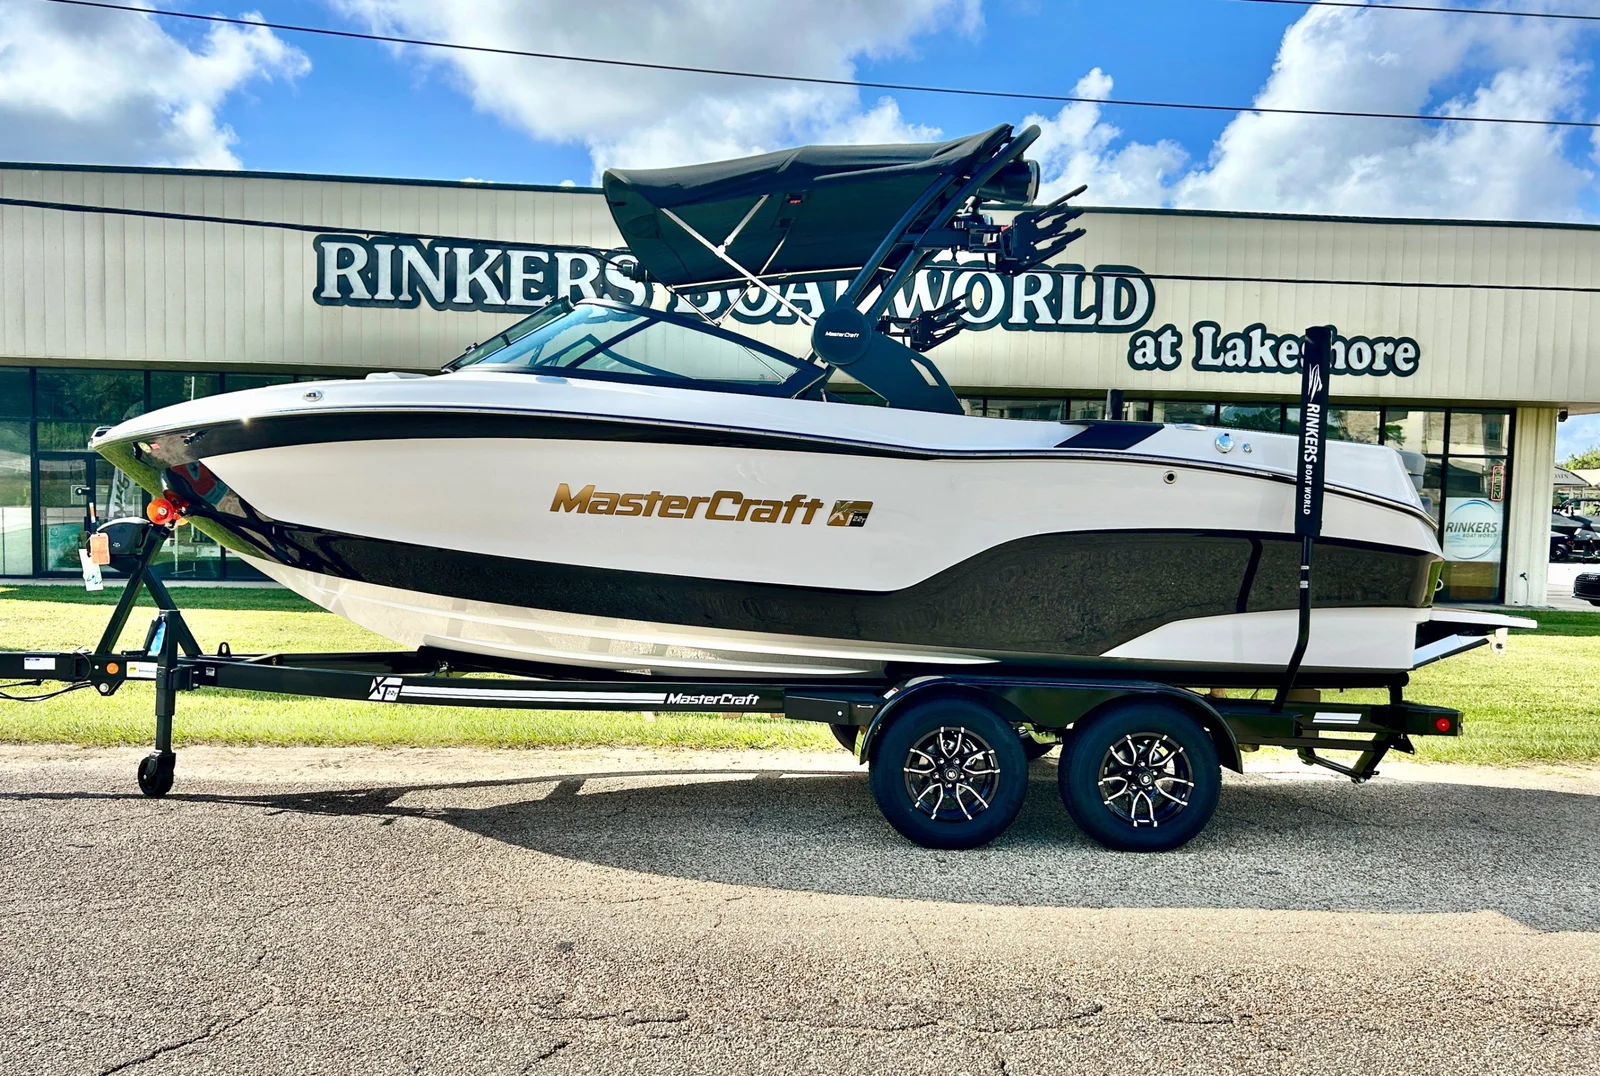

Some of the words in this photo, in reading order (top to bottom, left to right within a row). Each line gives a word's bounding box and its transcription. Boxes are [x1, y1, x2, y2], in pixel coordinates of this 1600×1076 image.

[319, 240, 647, 307] RINKERS
[893, 268, 1150, 326] WORLD
[1133, 328, 1178, 365] at
[1198, 326, 1417, 371] Lakehore
[1304, 403, 1320, 463] RINKERS
[1304, 464, 1313, 486] BOAT
[549, 482, 825, 525] MasterCraft
[1303, 486, 1312, 515] WORLD
[1445, 521, 1498, 533] RINKERS
[666, 692, 760, 705] MasterCraft
